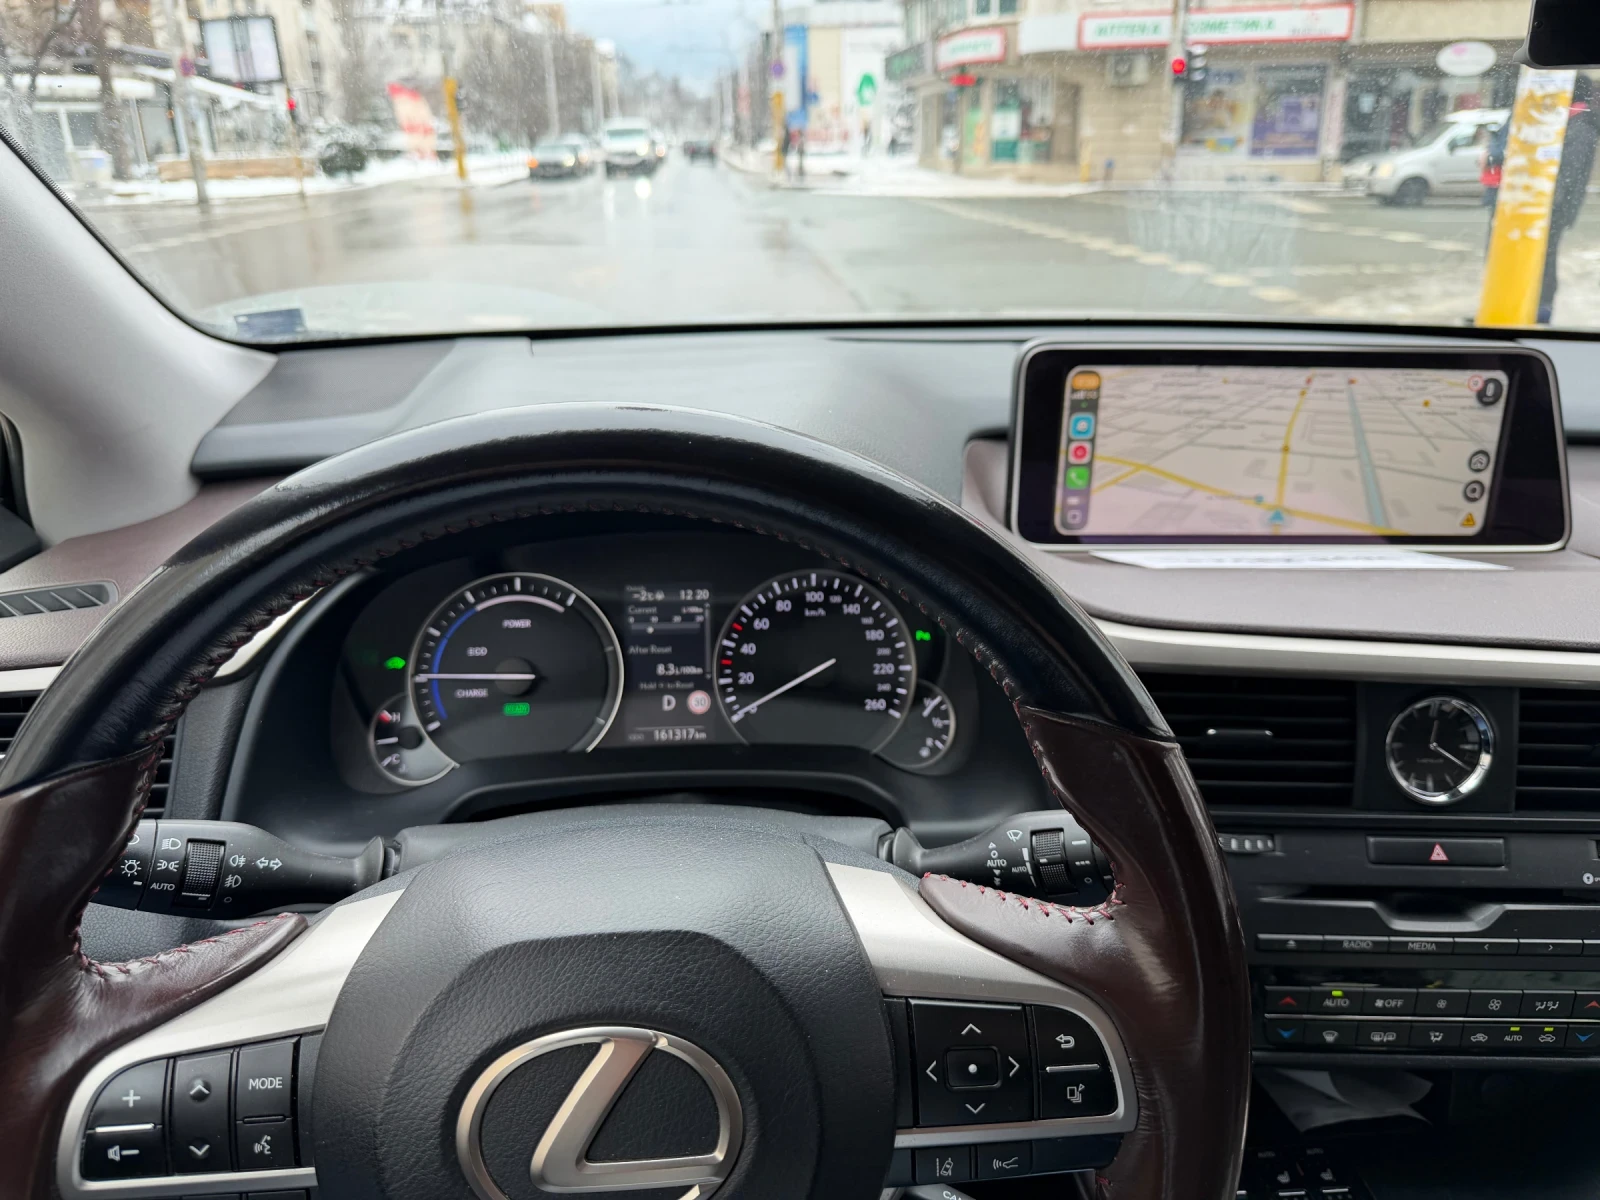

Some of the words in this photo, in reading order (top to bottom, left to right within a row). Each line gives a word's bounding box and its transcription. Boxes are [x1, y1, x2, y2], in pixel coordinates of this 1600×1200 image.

[805, 591, 825, 602] 100
[775, 600, 792, 612] 80
[842, 603, 861, 615] 140
[804, 608, 826, 617] km/h
[503, 619, 531, 629] POWER
[753, 618, 770, 630] 60
[865, 629, 885, 641] 180
[467, 647, 487, 656] ECO
[740, 643, 757, 655] 40
[656, 663, 675, 676] 8.3
[873, 663, 895, 675] 220
[738, 672, 755, 684] 20
[456, 689, 488, 698] CHARGE
[662, 694, 677, 711] D
[864, 699, 887, 711] 260
[654, 728, 695, 741] 161317
[391, 754, 400, 764] C
[987, 859, 1007, 867] AUTO
[1012, 865, 1027, 873] AUTO
[150, 882, 175, 891] AUTO
[1342, 940, 1373, 949] RADIO
[1408, 942, 1437, 951] MEDIA
[1323, 998, 1350, 1008] AUTO
[1384, 998, 1405, 1008] OFF
[249, 1077, 283, 1089] MODE
